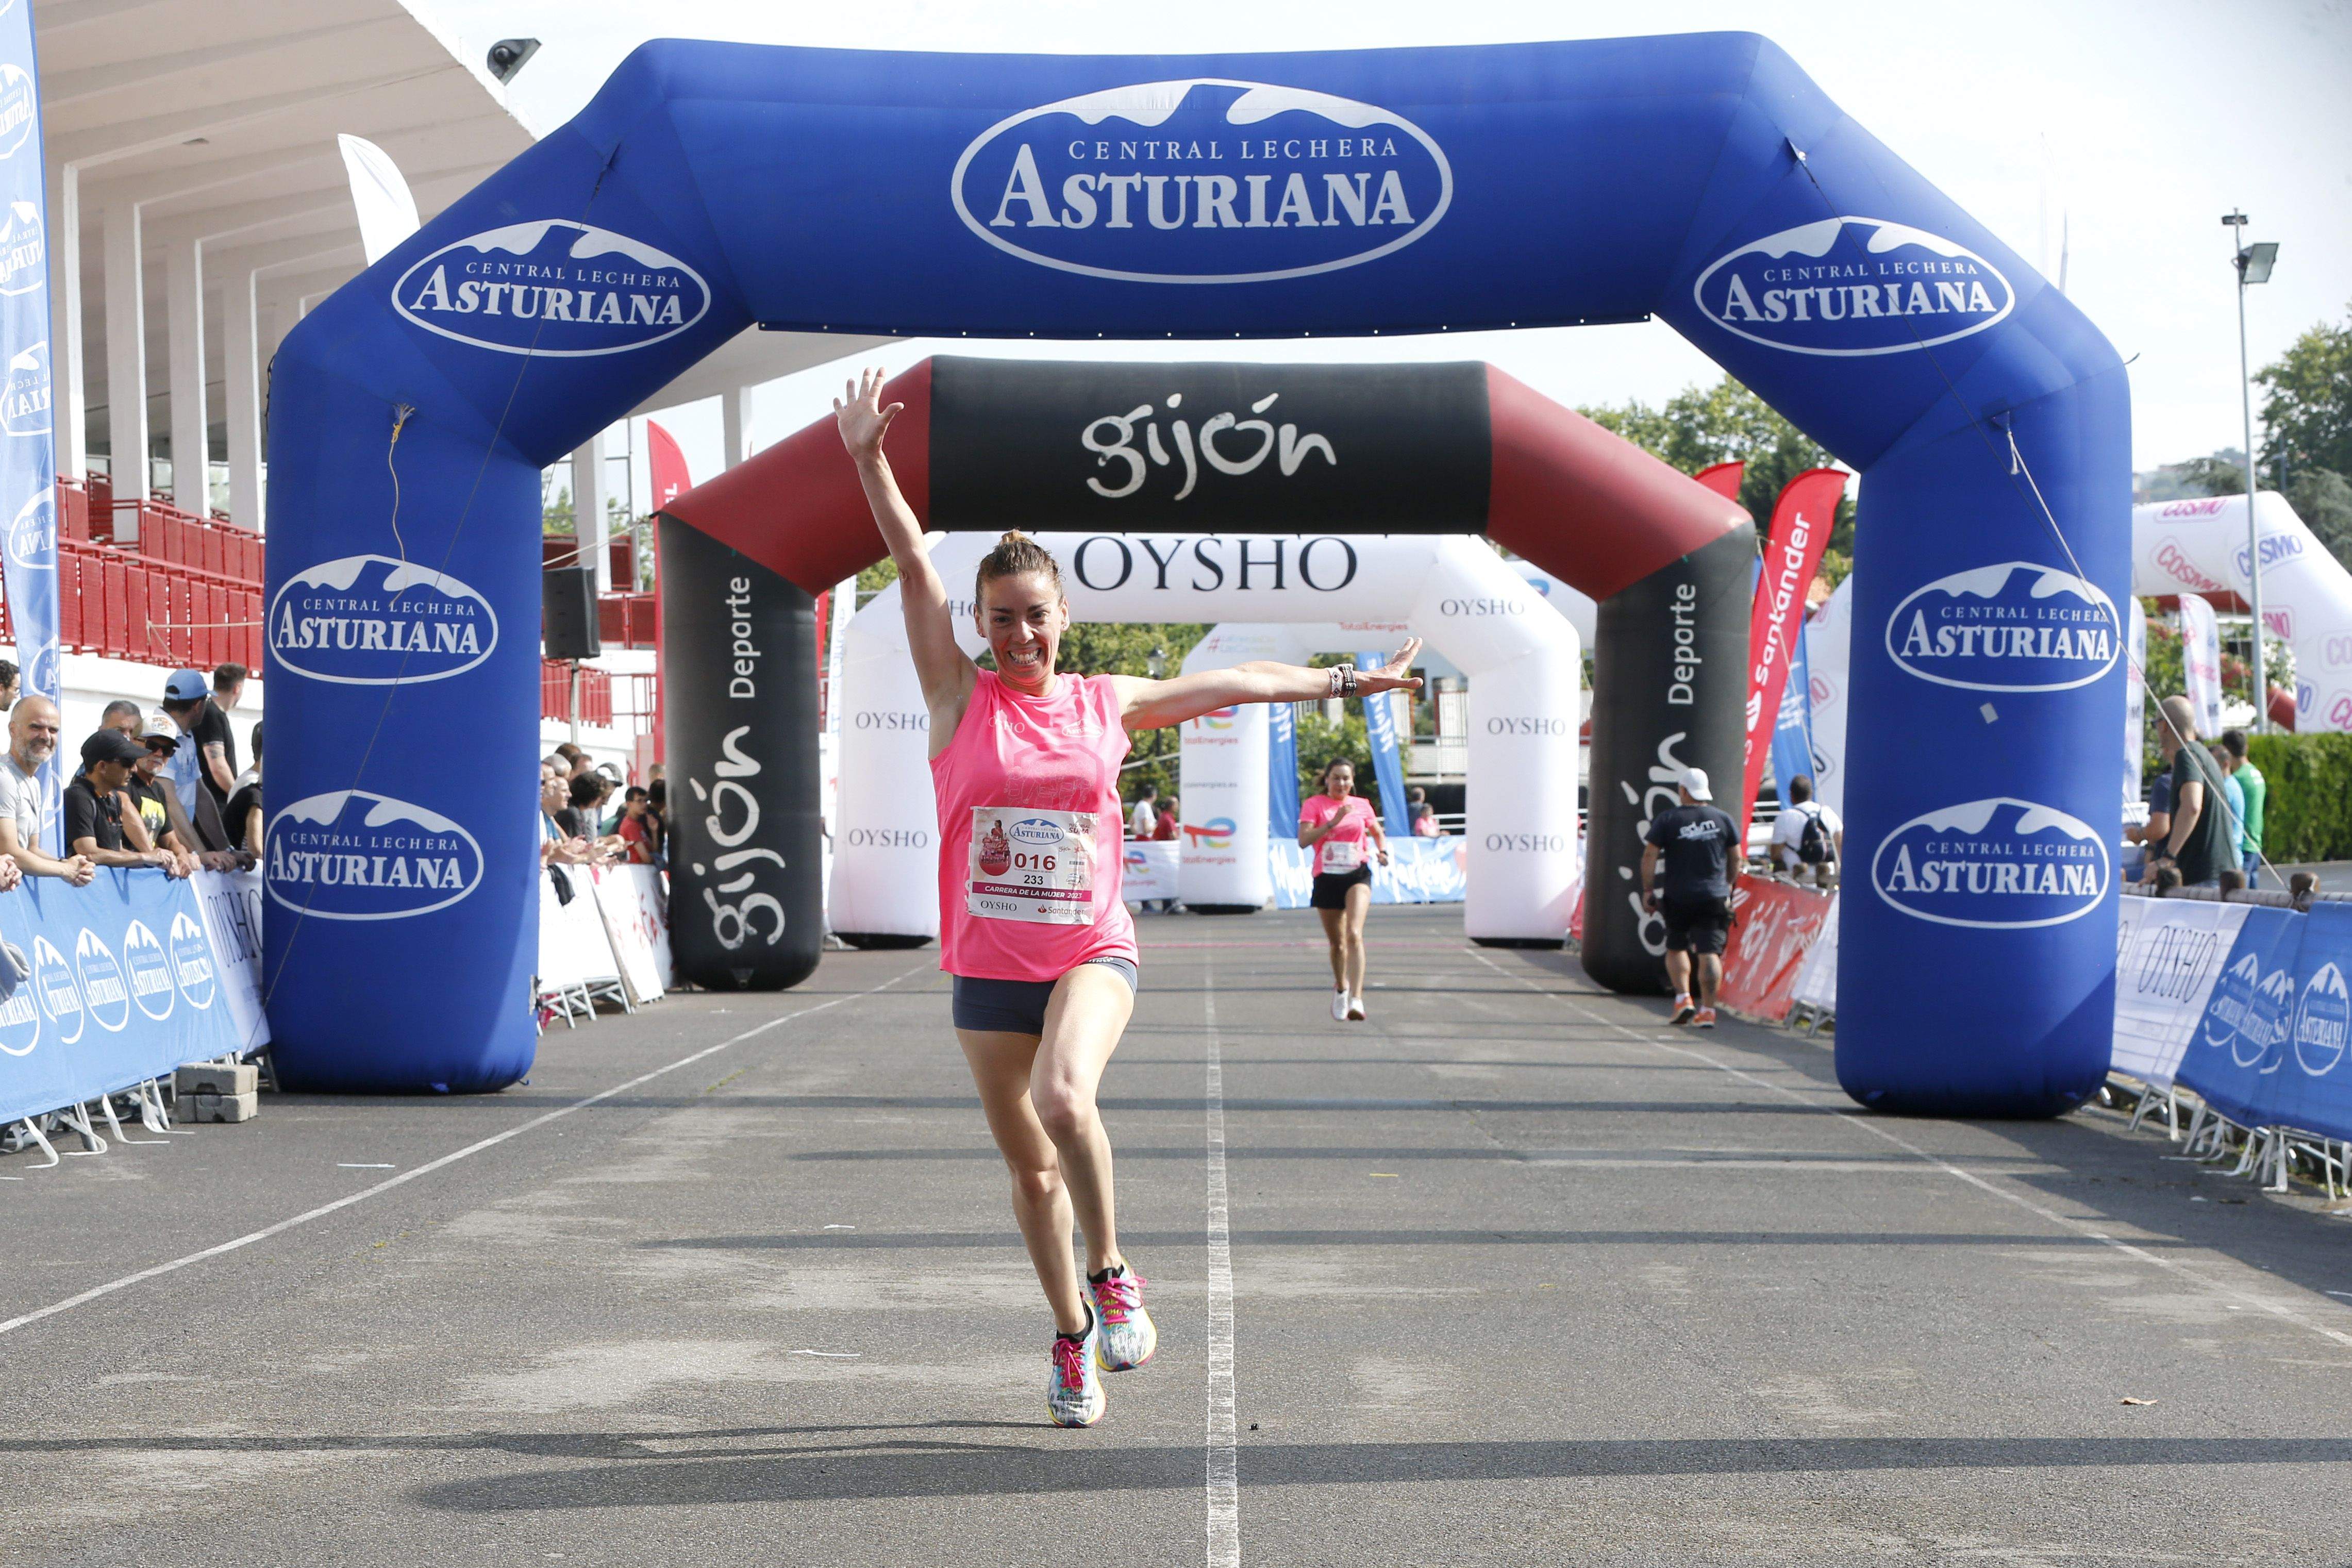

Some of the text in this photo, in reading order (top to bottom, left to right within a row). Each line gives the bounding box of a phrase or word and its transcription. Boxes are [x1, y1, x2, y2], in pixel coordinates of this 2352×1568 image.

[1069, 138, 1397, 160] CENTRAL LECHERA
[989, 143, 1415, 230] ASTURIANA
[466, 262, 680, 288] CENTRAL LECHERA
[1763, 262, 1979, 282] CENTRAL LECHERA
[410, 264, 683, 326] ASTURIANA
[1722, 273, 1997, 323] ASTURIANA
[1081, 393, 1336, 501] gijón
[1074, 536, 1358, 591] OYSHO
[2238, 535, 2303, 577] CSMO
[303, 598, 475, 616] CENTRAL LECHERA
[1440, 598, 1525, 616] OYSHO
[1755, 511, 1810, 687] Santander
[1941, 606, 2110, 623] CENTRAL LECHERA
[276, 600, 480, 654] ASTURIANA
[725, 576, 761, 698] Deporte
[1900, 609, 2110, 661] ASTURIANA
[1667, 583, 1703, 705] Deporte
[855, 711, 930, 732] OYSHO
[1487, 716, 1566, 737] OYSHO
[291, 832, 459, 850] CENTRAL LECHERA
[689, 725, 786, 950] gijón
[848, 828, 928, 848] OYSHO
[1013, 827, 1060, 840] ASTURIANA
[1486, 833, 1564, 853] OYSHO
[1925, 841, 2095, 858] CENTRAL LECHERA
[269, 833, 464, 889] ASTURIANA
[1014, 853, 1056, 870] 016
[1886, 843, 2098, 896] ASTURIANA
[985, 886, 1017, 895] CARRERA
[1024, 875, 1043, 885] 233
[980, 900, 1017, 912] OYSHO
